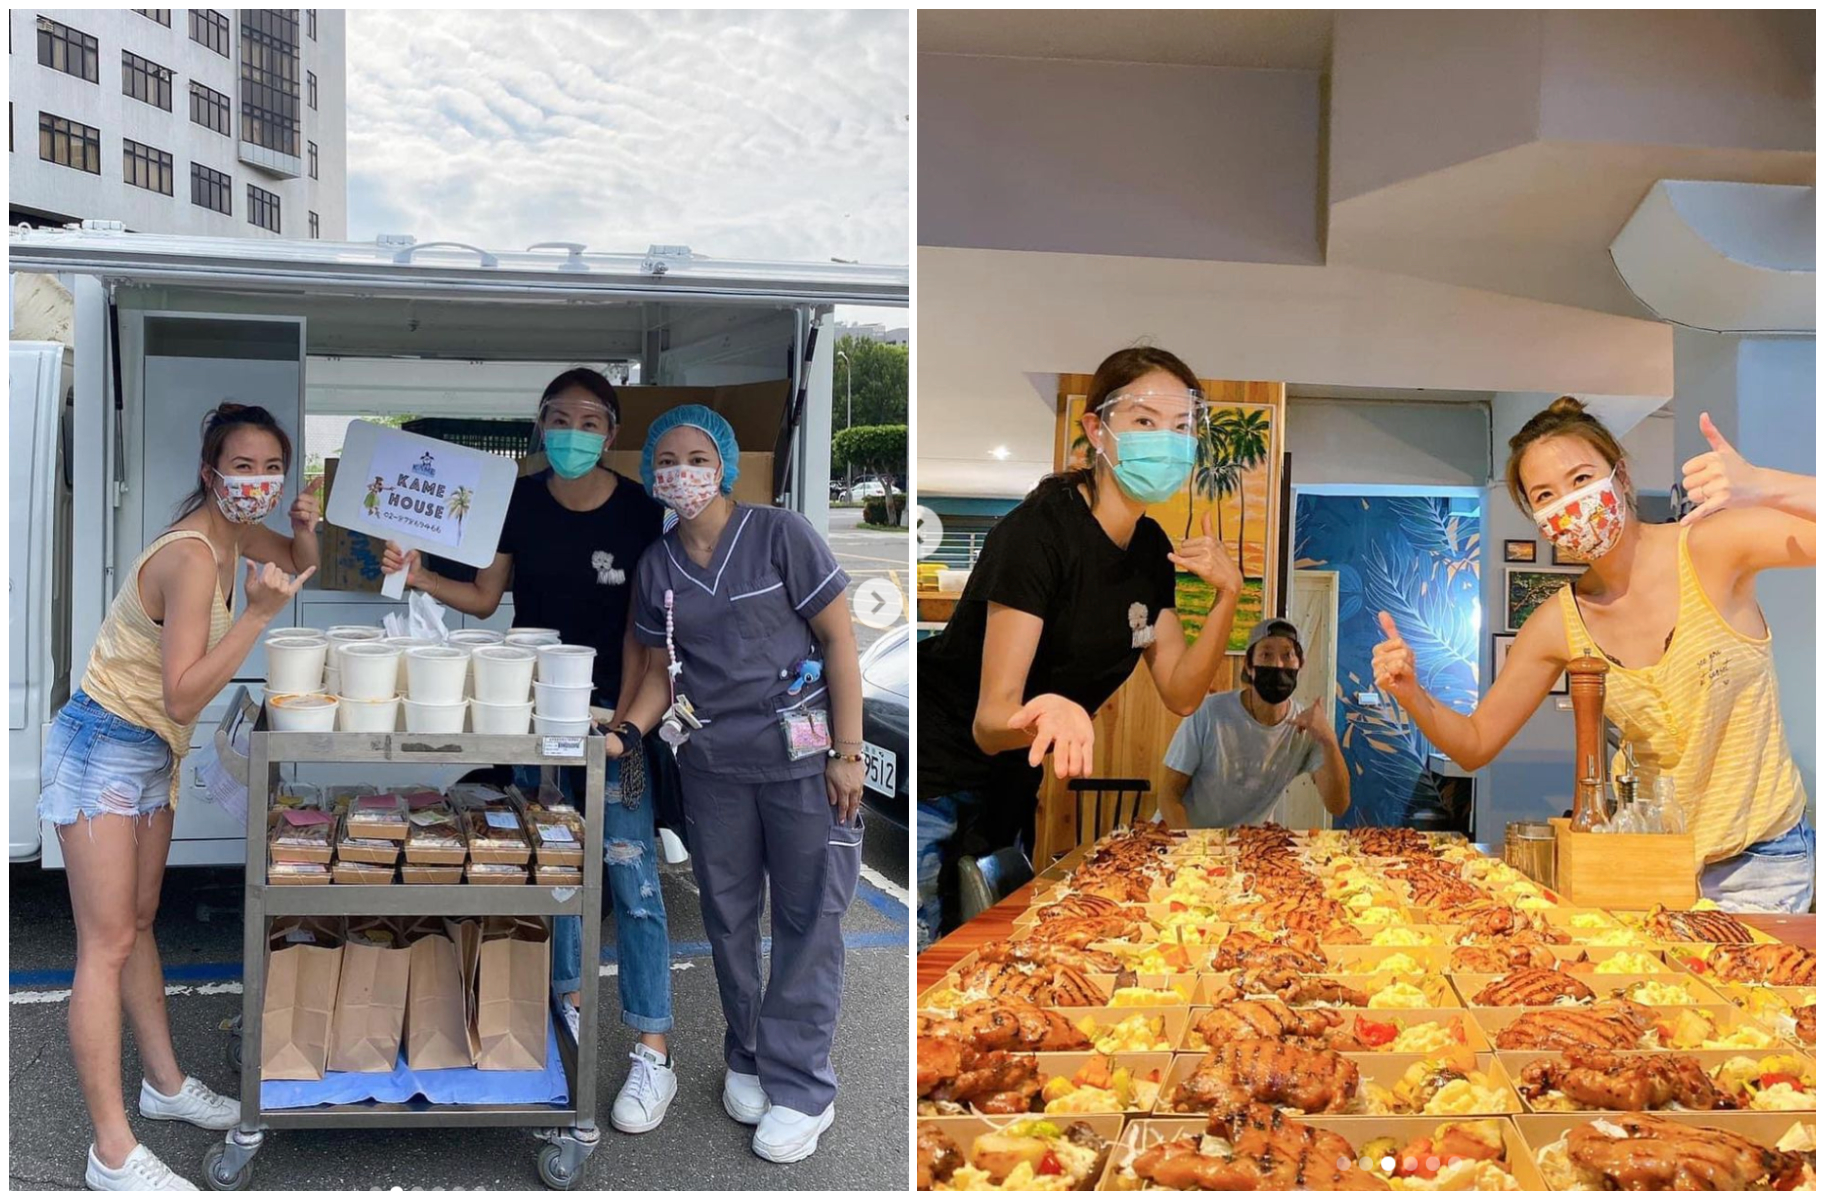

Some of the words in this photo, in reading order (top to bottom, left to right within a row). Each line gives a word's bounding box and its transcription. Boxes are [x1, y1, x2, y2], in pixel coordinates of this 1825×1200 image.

[396, 473, 446, 499] KAME
[388, 492, 445, 520] HOUSE
[864, 753, 894, 790] 9512
